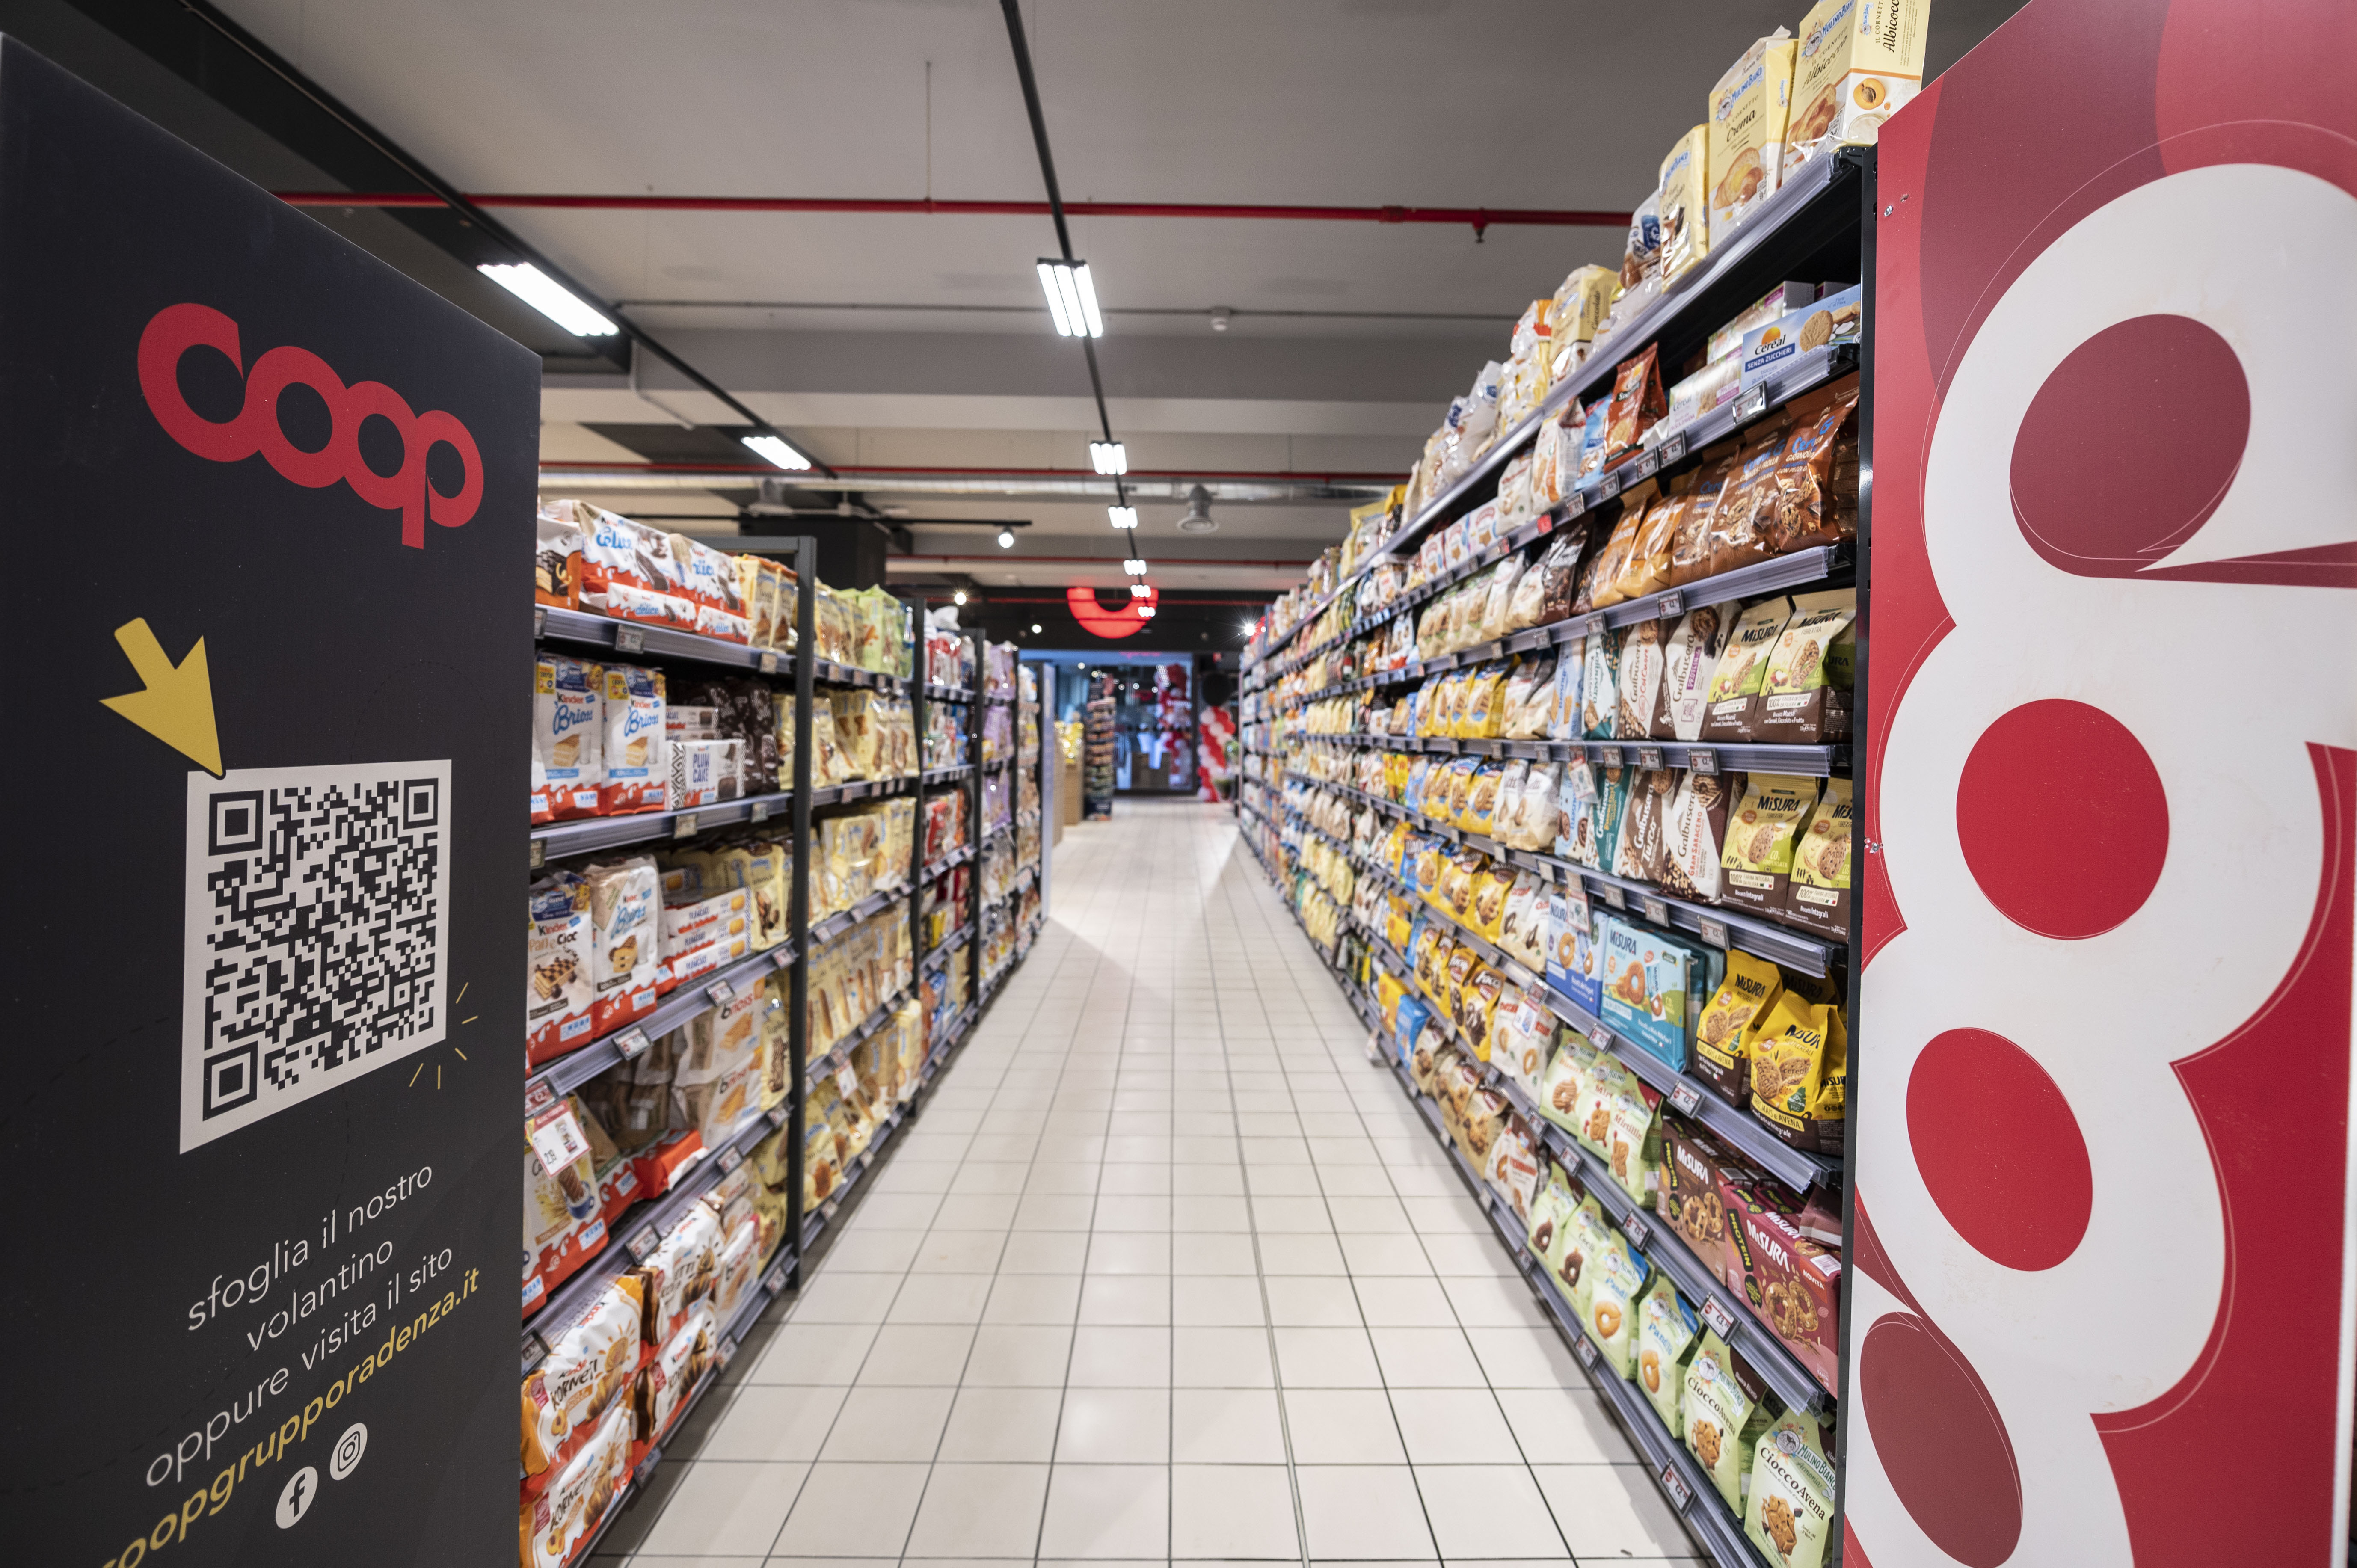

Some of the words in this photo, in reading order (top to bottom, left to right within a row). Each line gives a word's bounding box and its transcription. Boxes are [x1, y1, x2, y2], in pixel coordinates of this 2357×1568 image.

[1823, 12, 1842, 37] MULINO
[1875, 0, 1884, 34] CORNETT
[1883, 0, 1900, 53] Albicocc
[1731, 80, 1749, 101] MULINO
[1749, 65, 1763, 86] BIANCO
[1727, 109, 1756, 142] Crema
[1747, 357, 1765, 370] SENZA
[1765, 346, 1793, 363] ZUCCHERI
[1755, 334, 1786, 355] Céréal
[138, 302, 484, 550] coop
[1740, 625, 1779, 642] MiSURA
[1797, 611, 1842, 628] MiSURA
[1593, 645, 1602, 704] Galbusera
[1631, 640, 1641, 703] Galbusera
[1673, 634, 1695, 702] Galbusera
[1828, 656, 1849, 667] URA
[557, 691, 584, 705] Kinder
[631, 699, 651, 709] Kinder
[1768, 698, 1781, 708] 100%
[553, 702, 593, 735] Brioss
[624, 708, 659, 738] Brioss
[692, 753, 710, 768] PLUM
[692, 768, 709, 783] CAKE
[1633, 783, 1654, 849] Galbusera
[1757, 795, 1800, 812] MiSURA
[1832, 804, 1852, 820] MiS
[1678, 791, 1696, 857] Galbusera
[1691, 811, 1703, 854] SARACENO
[1641, 815, 1657, 863] Turco
[1688, 854, 1696, 877] GRAN
[1730, 873, 1743, 884] 100%
[1755, 875, 1773, 883] INTEGRALE
[1734, 889, 1746, 898] Biscotti
[1746, 890, 1764, 902] Integrali
[1798, 888, 1814, 900] 100%
[1800, 905, 1811, 914] Biscotti
[1811, 906, 1829, 919] Integrali
[537, 922, 568, 937] Kinder
[1610, 928, 1637, 956] MiSURA
[1734, 972, 1766, 999] MiSURA
[1717, 1053, 1731, 1066] AVENA
[1761, 1105, 1773, 1117] MAIS
[1779, 1114, 1800, 1129] AVENA
[1770, 1121, 1791, 1138] Integrale
[1665, 1142, 1678, 1187] PROTEIN
[1677, 1144, 1709, 1185] MiSURA
[1765, 1211, 1800, 1239] MiSURA
[187, 1239, 309, 1332] sfoglia
[322, 1209, 337, 1250] il
[348, 1165, 433, 1234] nostro
[1730, 1212, 1751, 1267] PROTEIN
[1746, 1219, 1790, 1273] MiSURA
[1803, 1269, 1825, 1290] NOVITÀ
[246, 1239, 394, 1352] volantino
[145, 1366, 290, 1488] oppure
[300, 1301, 377, 1371] visita
[387, 1273, 400, 1311] il
[409, 1247, 453, 1293] sito
[1716, 1369, 1734, 1390] MULINO
[1730, 1382, 1744, 1407] BIANCO
[1688, 1377, 1736, 1438] CioccoAvena
[1797, 1444, 1821, 1470] MULINO
[1760, 1446, 1825, 1521] CioccoAvena
